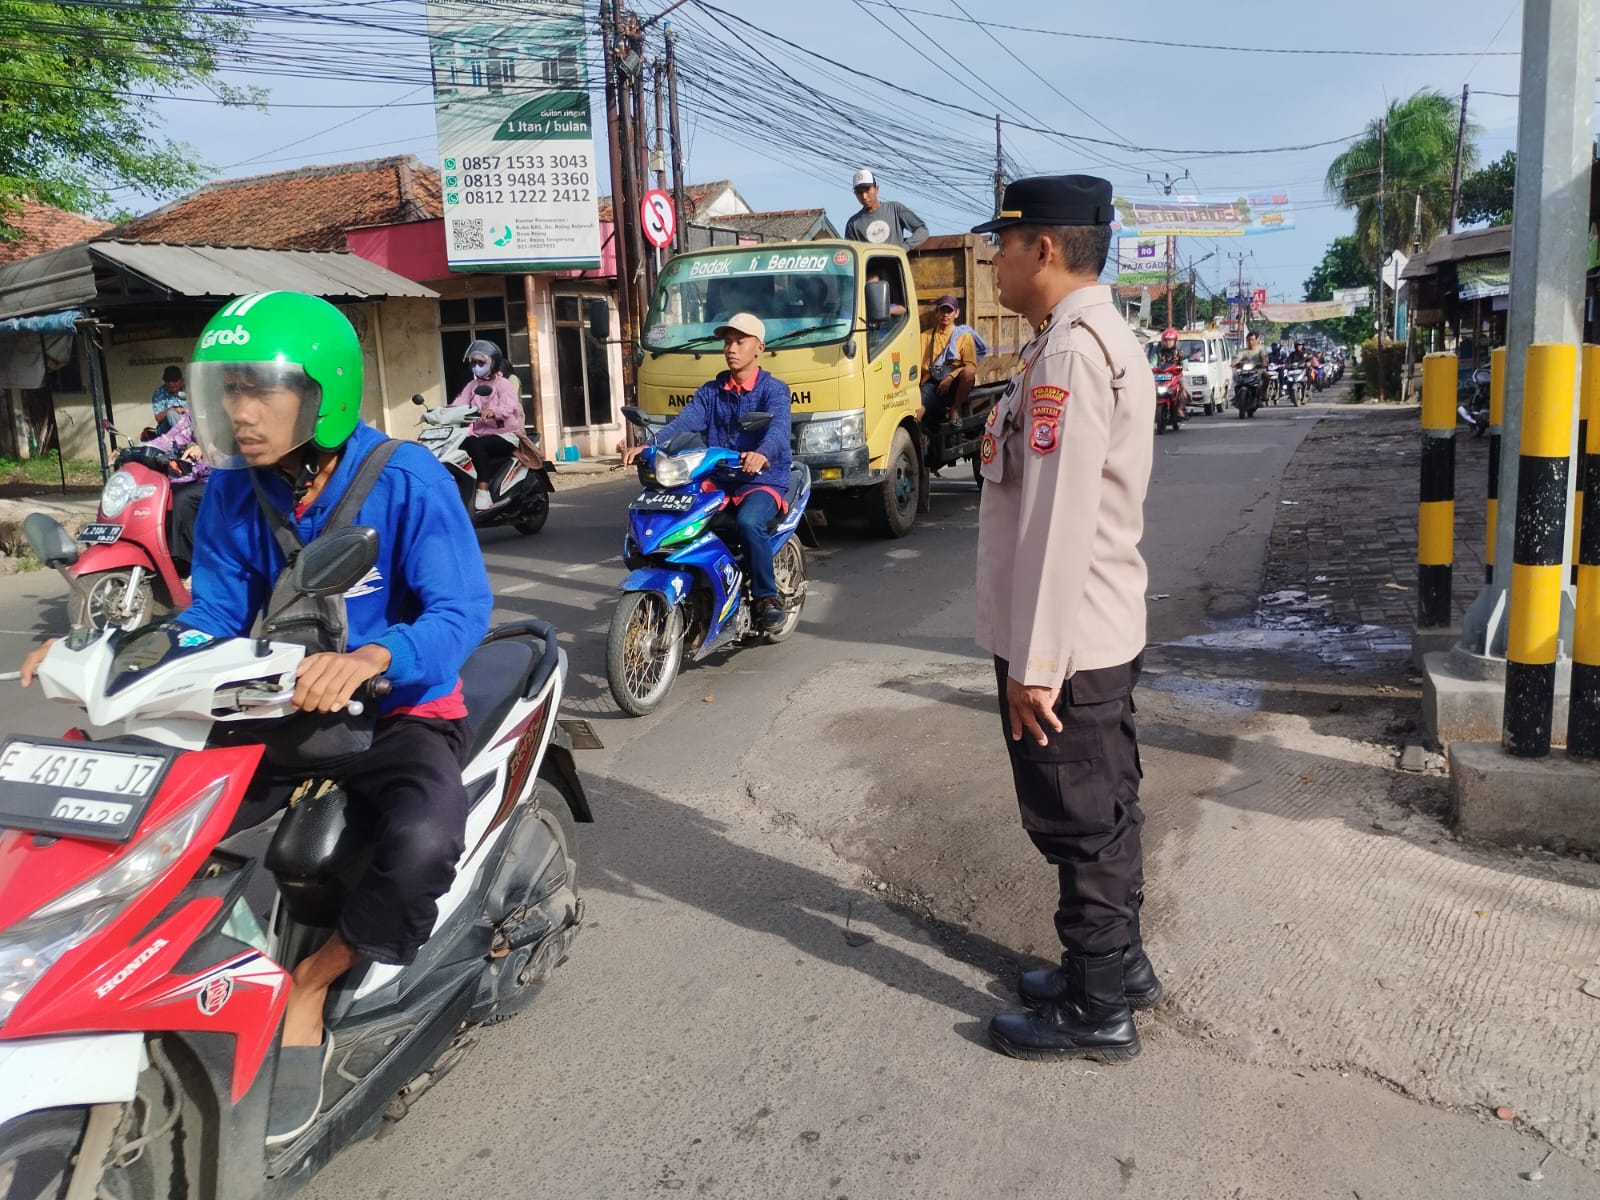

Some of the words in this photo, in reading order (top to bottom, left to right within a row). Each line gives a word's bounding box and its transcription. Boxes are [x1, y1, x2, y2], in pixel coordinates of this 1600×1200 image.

[508, 121, 515, 132] 1
[517, 121, 542, 132] Jtan
[554, 120, 587, 132] bulan
[462, 156, 501, 170] 0857
[506, 155, 545, 169] 1533
[550, 155, 588, 168] 3043
[464, 174, 503, 188] 0813
[507, 173, 546, 187] 9484
[551, 172, 589, 186] 3360
[465, 191, 504, 204] 0812
[509, 190, 548, 203] 1222
[552, 189, 591, 202] 2412
[690, 258, 733, 276] Badak
[767, 254, 829, 271] Benteng
[201, 324, 251, 348] Grab
[30, 754, 99, 787] 4615
[116, 763, 156, 795] JZ
[94, 938, 169, 999] HONDA
